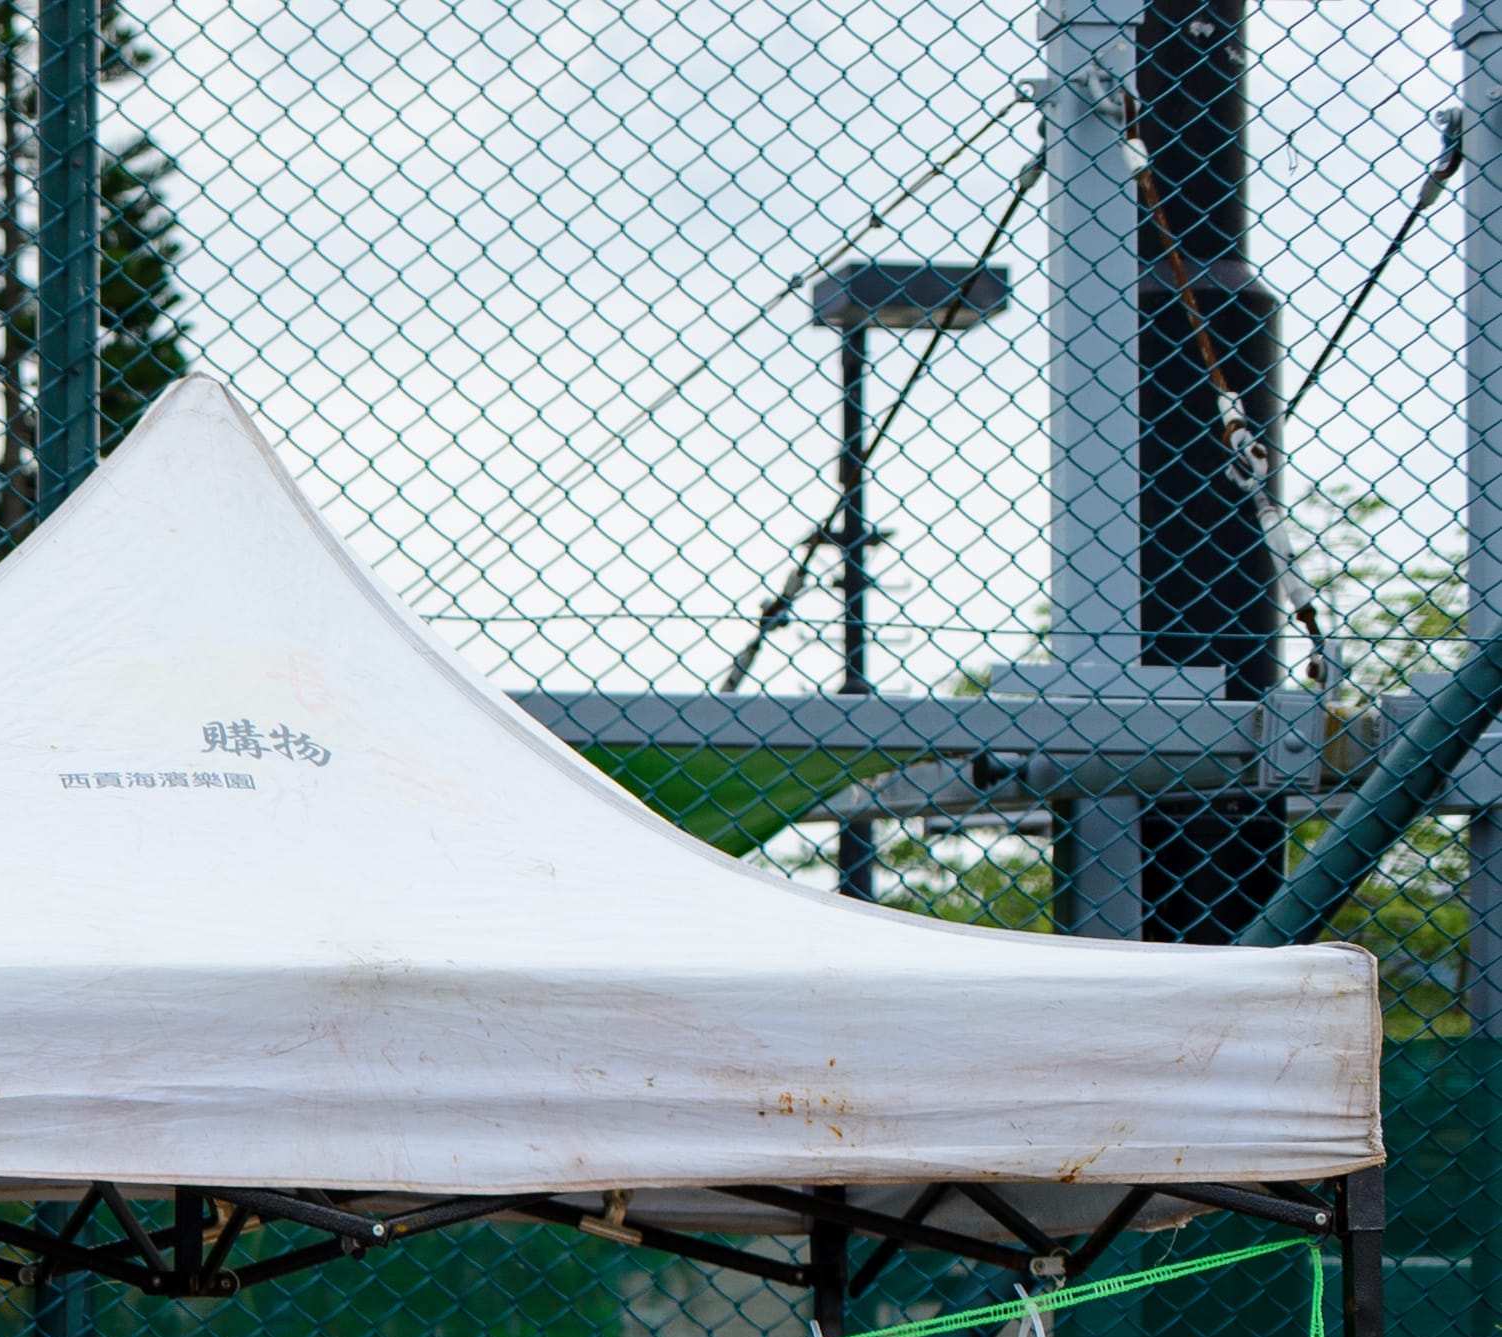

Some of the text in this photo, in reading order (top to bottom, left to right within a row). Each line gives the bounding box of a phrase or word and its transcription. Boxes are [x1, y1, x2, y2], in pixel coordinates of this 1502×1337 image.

[200, 718, 332, 767] 購物
[58, 771, 257, 791] 西貢海濱樂園
